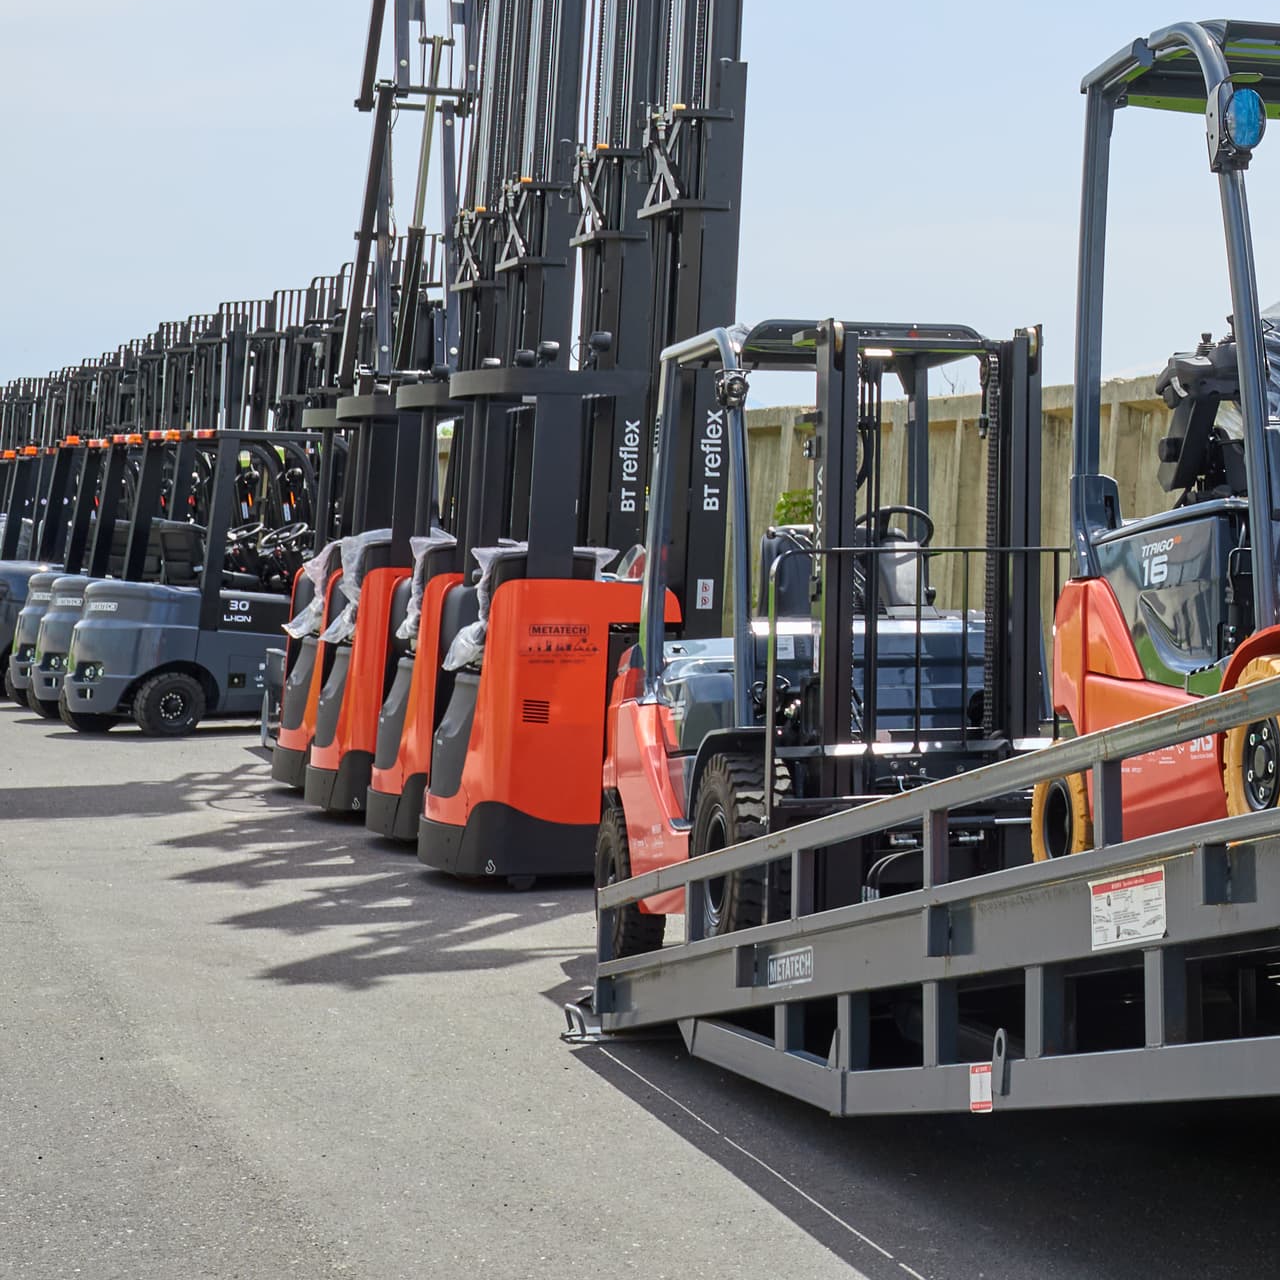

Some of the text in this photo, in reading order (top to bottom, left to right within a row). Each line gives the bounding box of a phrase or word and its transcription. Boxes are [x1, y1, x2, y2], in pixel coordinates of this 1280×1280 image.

[619, 420, 641, 512] BT reflex
[701, 410, 724, 511] BT reflex
[814, 464, 824, 573] TOYOTA
[1142, 538, 1174, 557] TRAIGO
[1143, 554, 1168, 586] 16
[229, 600, 250, 611] 30
[532, 626, 586, 634] METATECH
[769, 952, 812, 983] METATECH
